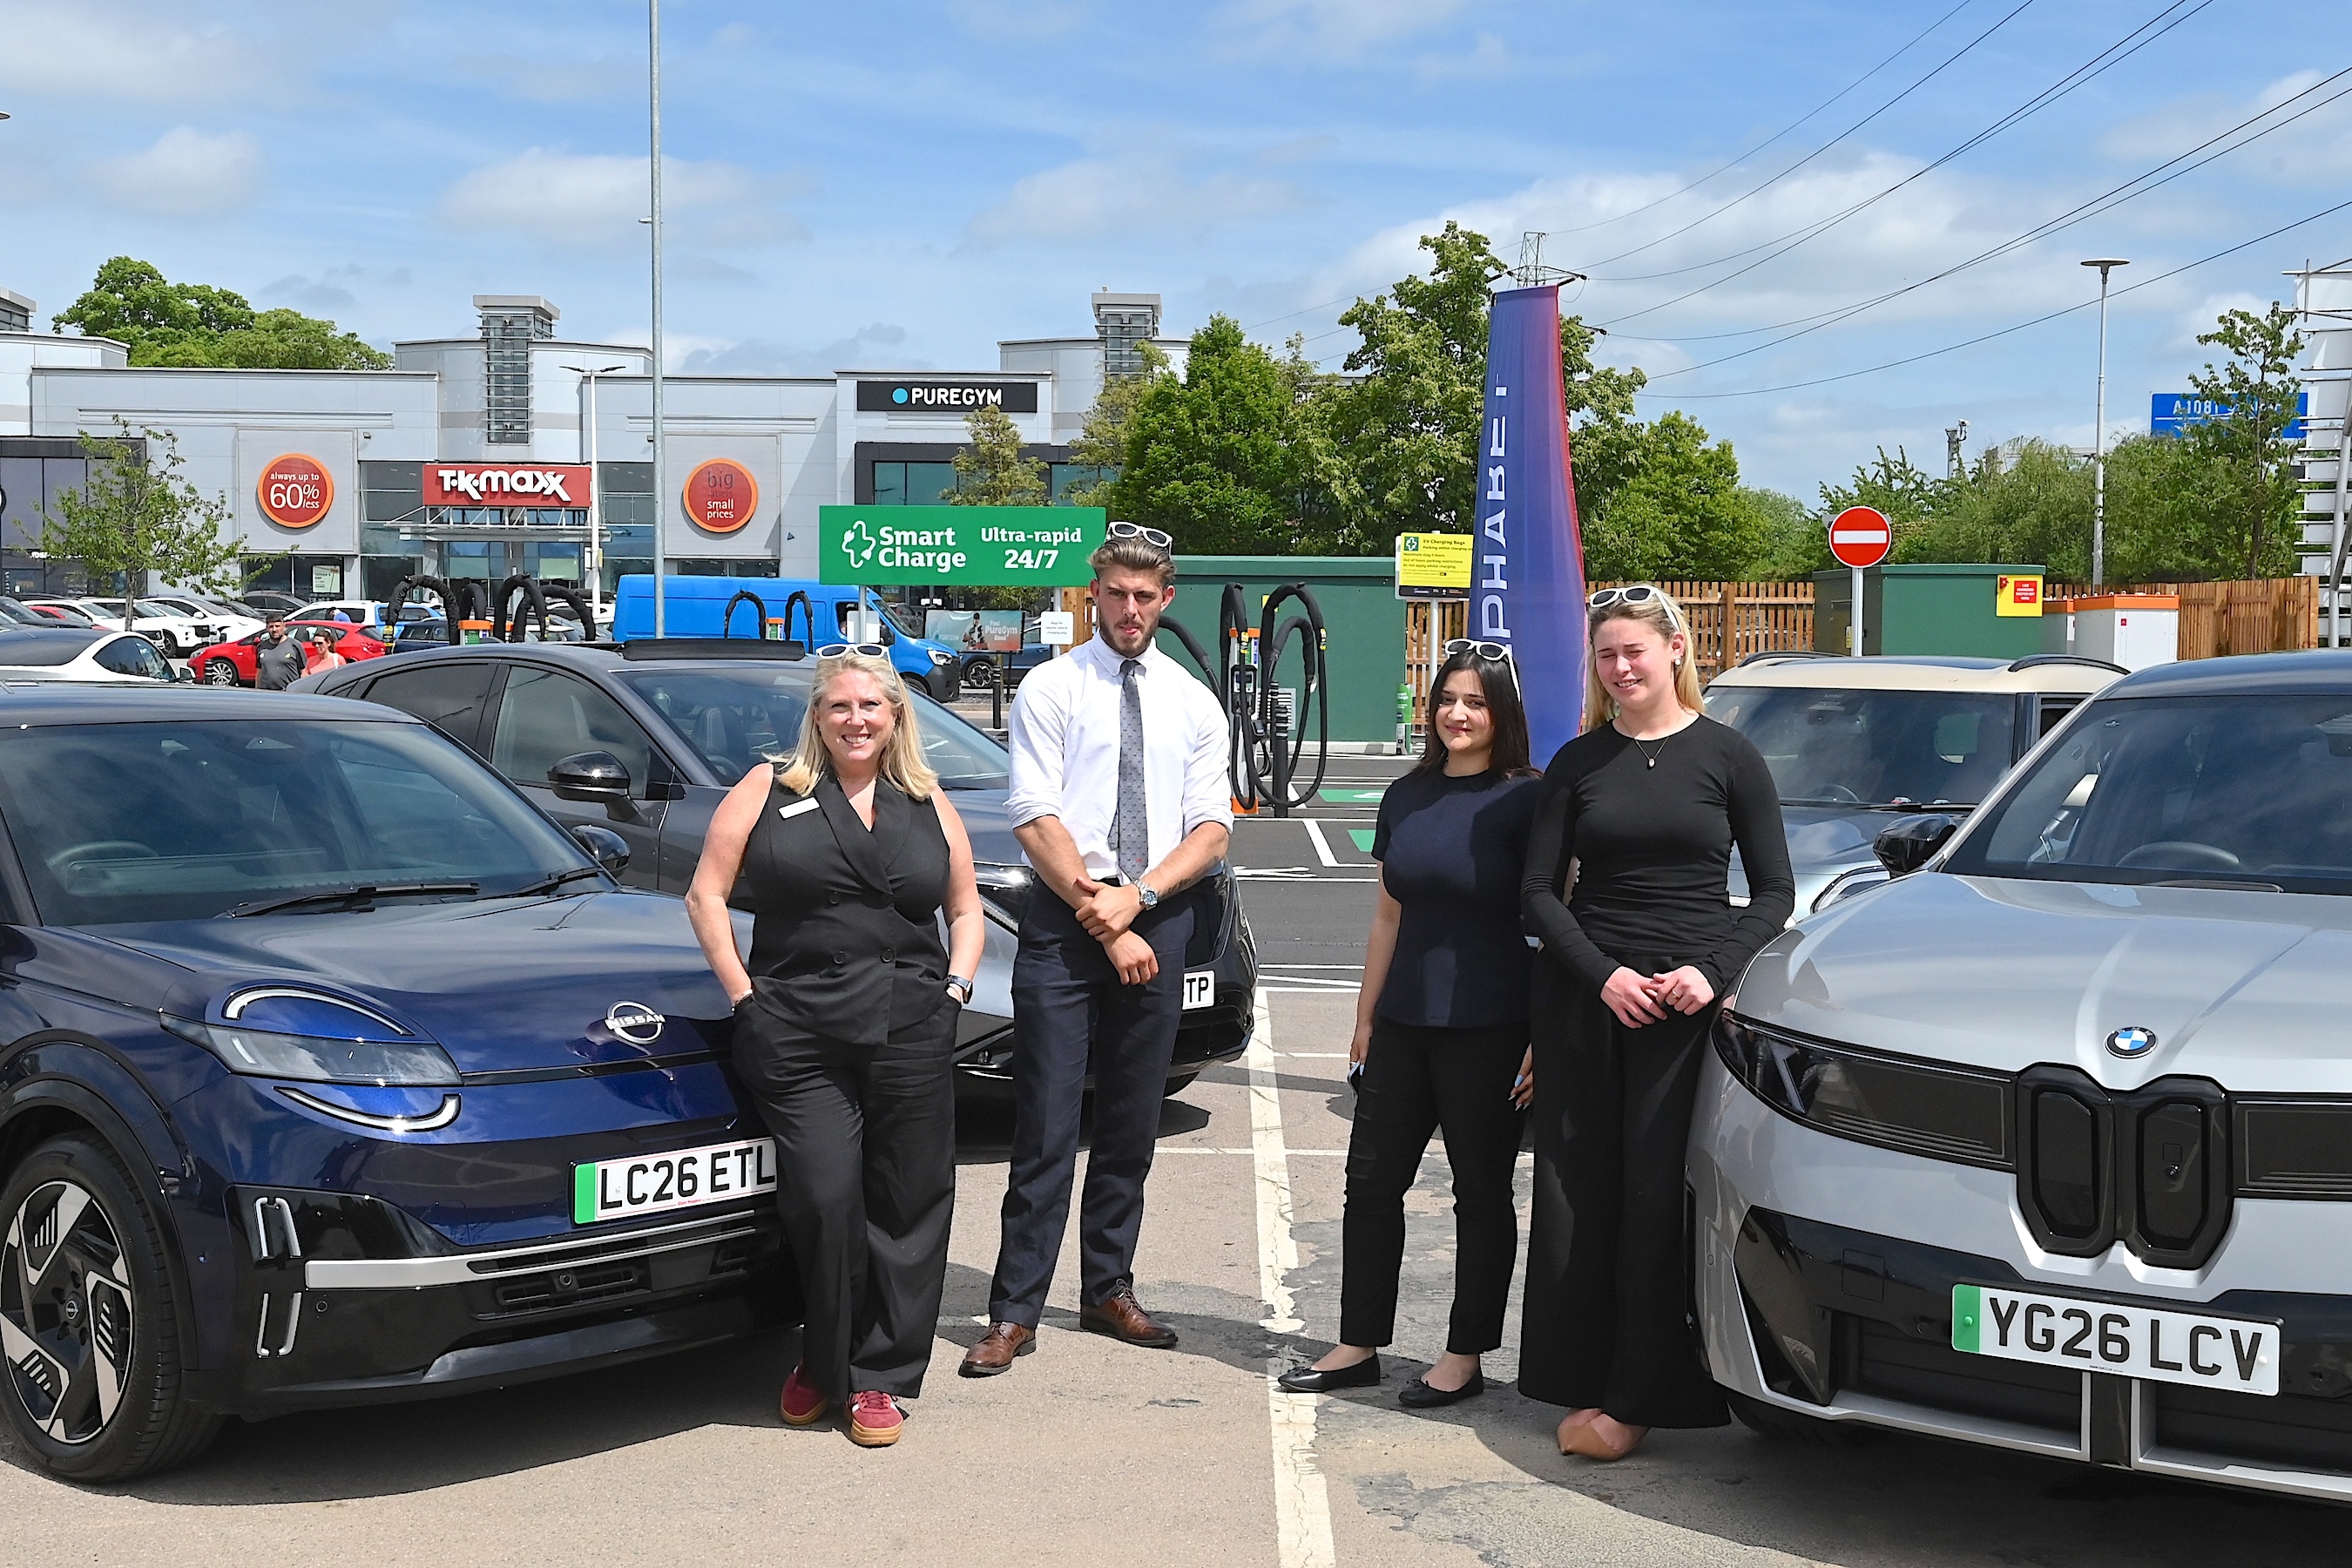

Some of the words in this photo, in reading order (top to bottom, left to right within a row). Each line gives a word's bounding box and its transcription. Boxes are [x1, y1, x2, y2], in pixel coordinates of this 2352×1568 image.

[911, 388, 1002, 406] PUREGYM
[270, 471, 296, 482] always
[707, 470, 733, 490] big
[270, 483, 320, 509] 60%
[302, 499, 320, 509] less
[706, 498, 734, 510] small
[706, 509, 734, 520] prices
[879, 526, 956, 547] Smart
[981, 527, 1082, 547] Ultra-rapid
[878, 547, 967, 573] Charge
[1004, 549, 1059, 570] 24/7
[984, 625, 1017, 637] PureGym
[1186, 977, 1209, 1003] TP
[605, 1014, 666, 1030] NISSAN
[600, 1156, 698, 1210] LC26
[710, 1145, 776, 1193] ETL
[1989, 1297, 2131, 1364] YG26
[2150, 1318, 2262, 1382] LCV
